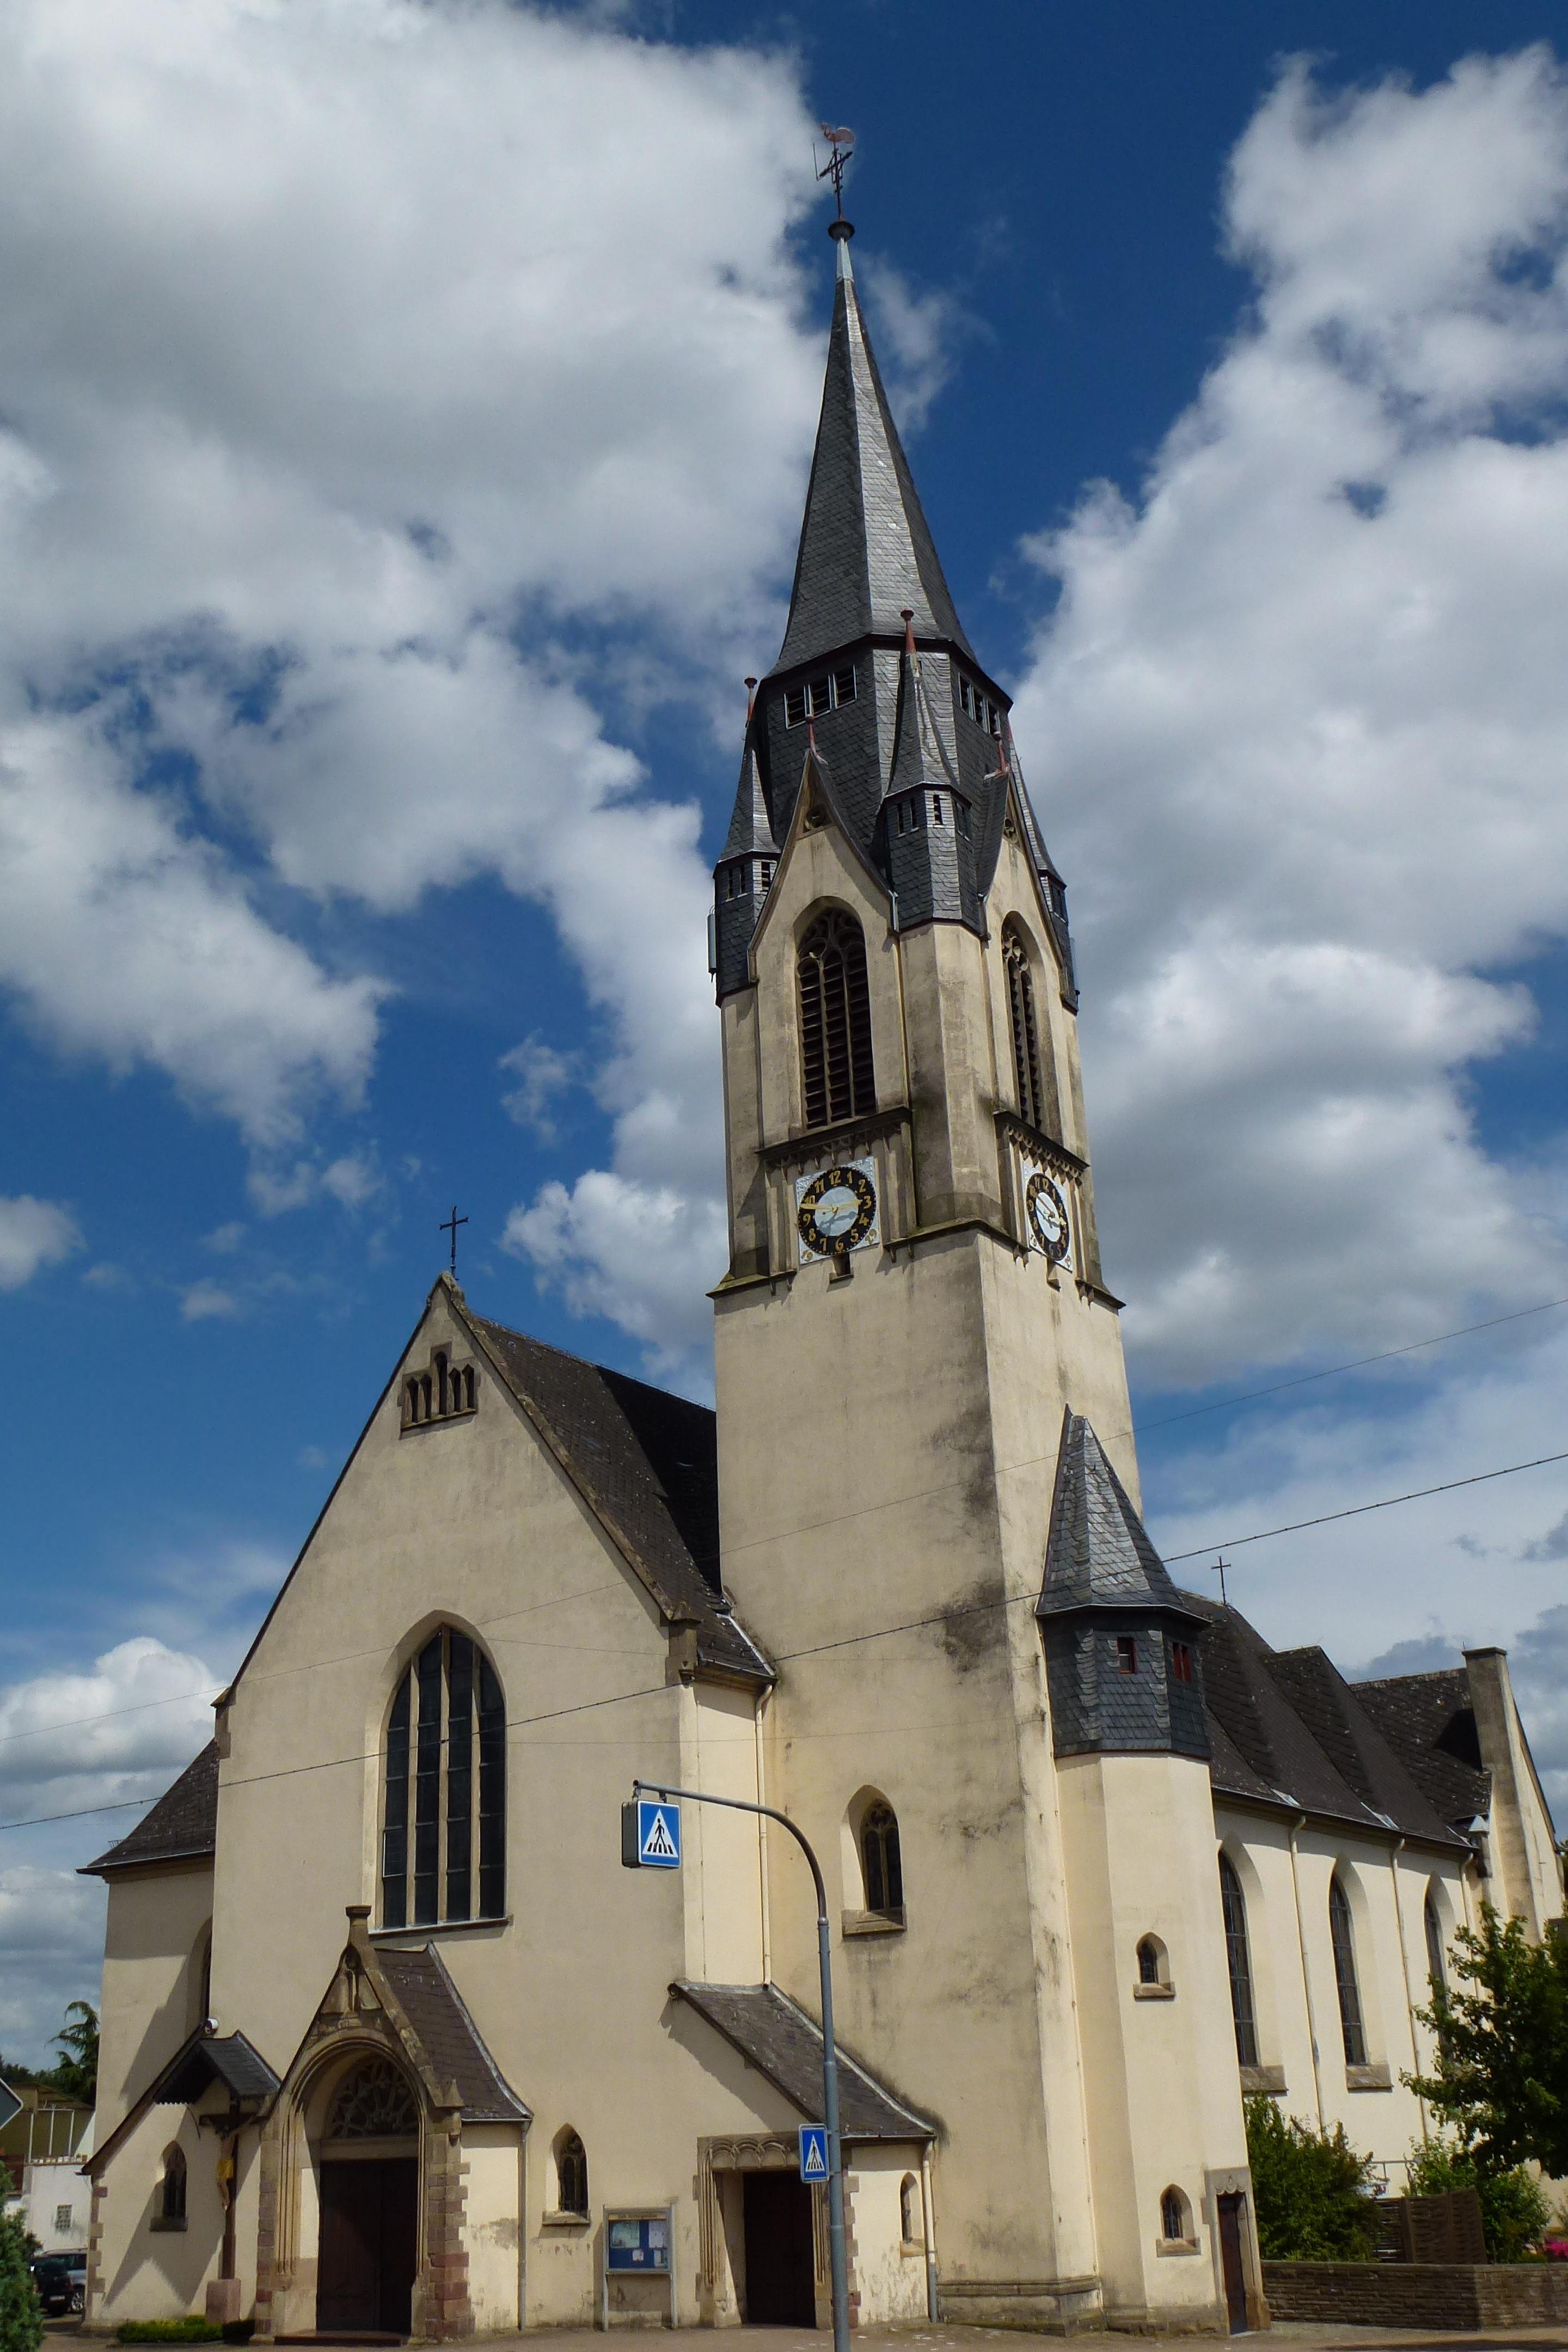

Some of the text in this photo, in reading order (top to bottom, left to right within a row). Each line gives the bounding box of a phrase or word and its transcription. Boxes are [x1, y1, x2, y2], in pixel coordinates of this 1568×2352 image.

[829, 1170, 841, 1185] 12
[847, 1171, 853, 1184] 1
[1034, 1176, 1040, 1189] 11
[814, 1179, 825, 1193] 11
[859, 1179, 866, 1193] 2
[1052, 1188, 1056, 1200] 1
[863, 1196, 872, 1209] 3
[1027, 1199, 1034, 1211] 9
[1058, 1203, 1063, 1216] 2
[803, 1213, 811, 1227] 9
[859, 1212, 869, 1226] 4
[1033, 1217, 1038, 1230] 8
[808, 1228, 816, 1241] 8
[850, 1229, 859, 1242] 5
[1040, 1233, 1044, 1248] 7
[1061, 1234, 1067, 1248] 4
[820, 1238, 827, 1251] 7
[835, 1236, 844, 1251] 6
[1049, 1244, 1054, 1256] 6
[1057, 1244, 1061, 1257] 5
